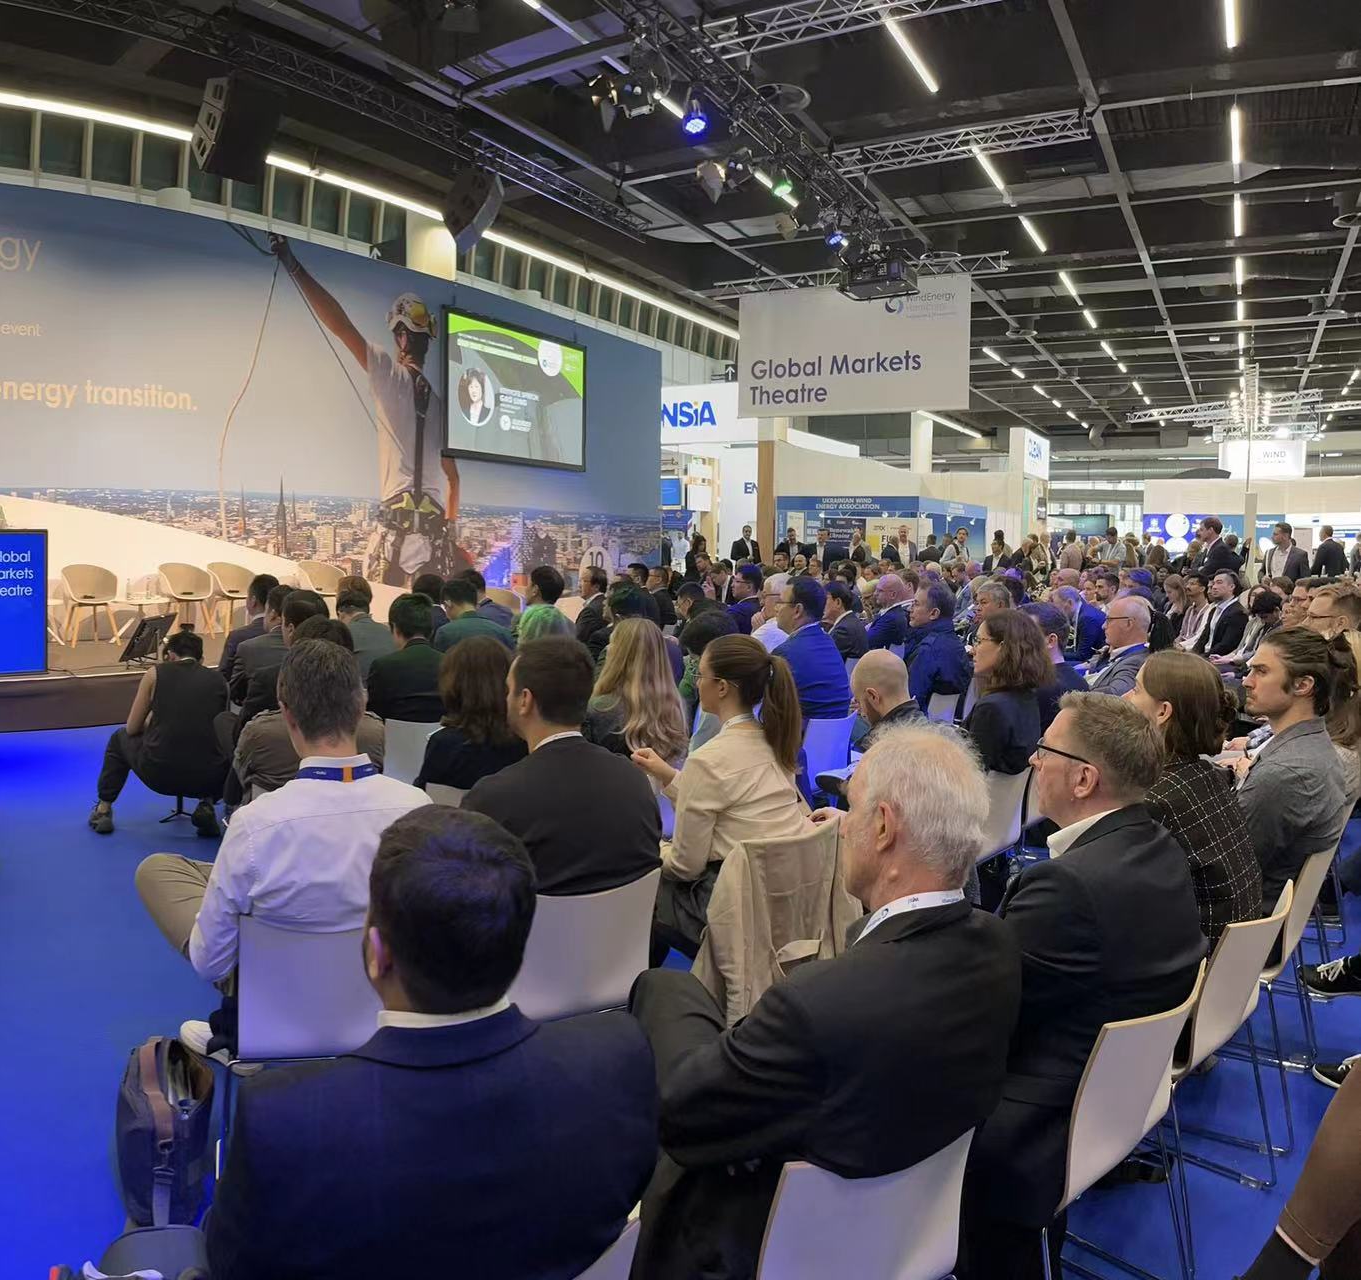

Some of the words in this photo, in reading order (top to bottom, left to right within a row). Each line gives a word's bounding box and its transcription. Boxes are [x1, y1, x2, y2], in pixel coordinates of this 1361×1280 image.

[1, 323, 41, 337] event
[751, 356, 822, 380] Global
[830, 350, 922, 375] Markets
[85, 380, 198, 411] transition.
[750, 384, 828, 405] Theatre
